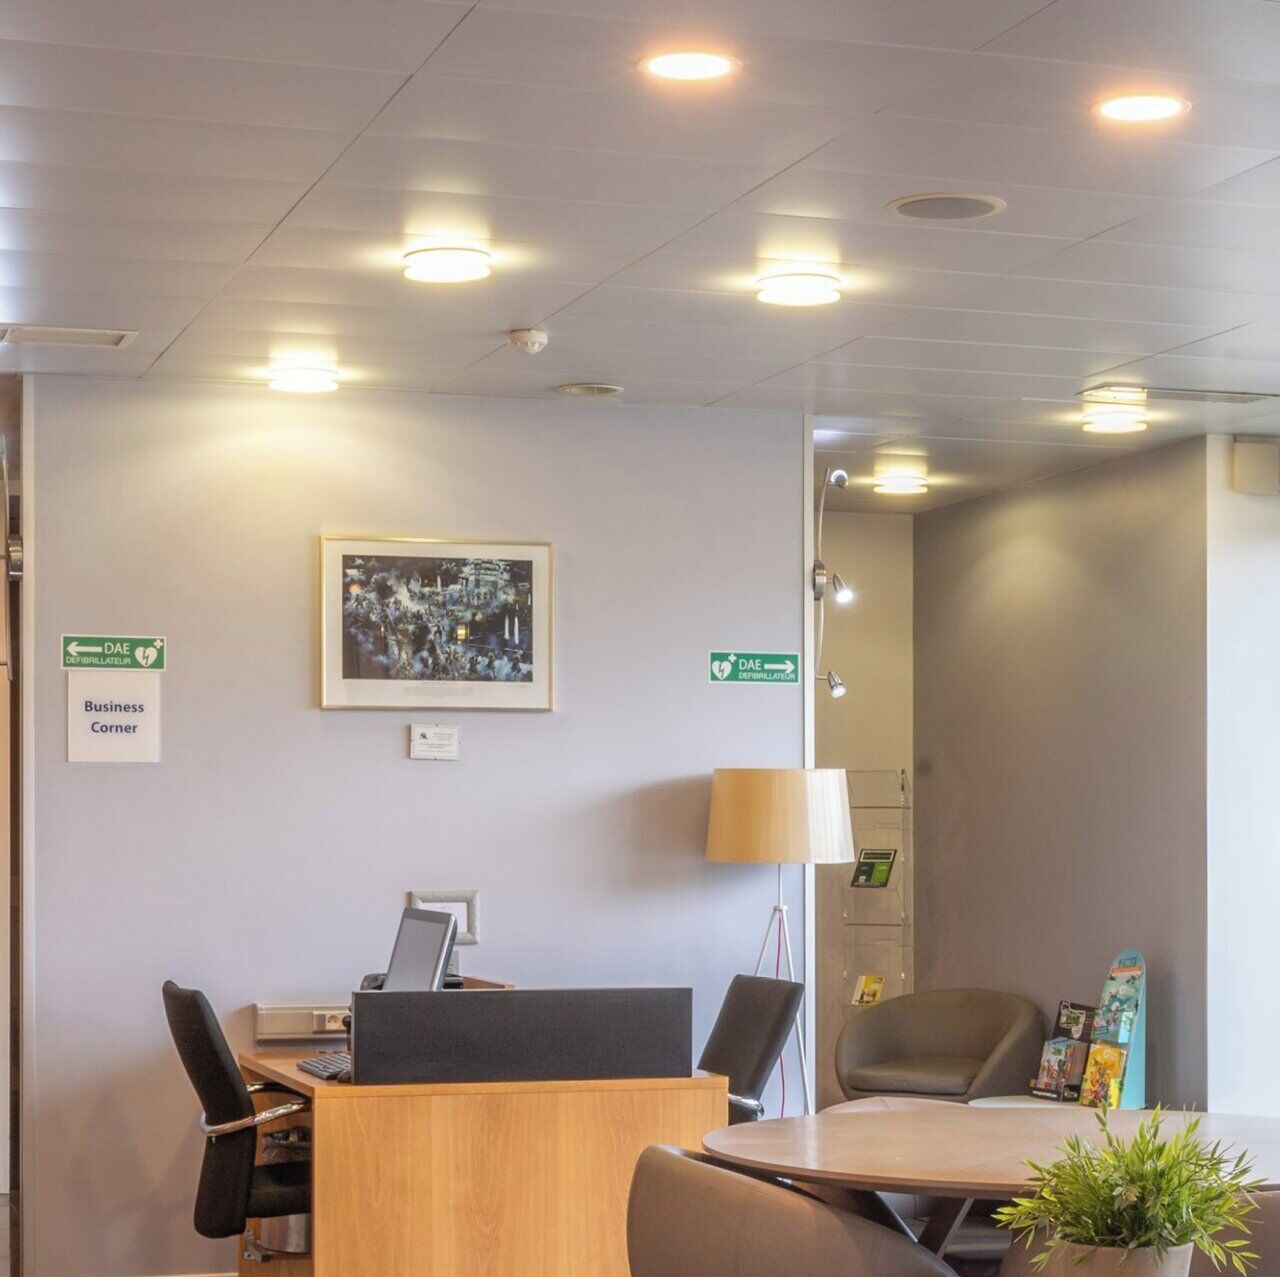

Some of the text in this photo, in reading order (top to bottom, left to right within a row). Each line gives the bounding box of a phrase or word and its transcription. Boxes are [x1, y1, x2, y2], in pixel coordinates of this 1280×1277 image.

[103, 641, 131, 655] DAE
[738, 659, 763, 671] DAE
[83, 699, 146, 714] Business
[90, 721, 139, 734] Corner
